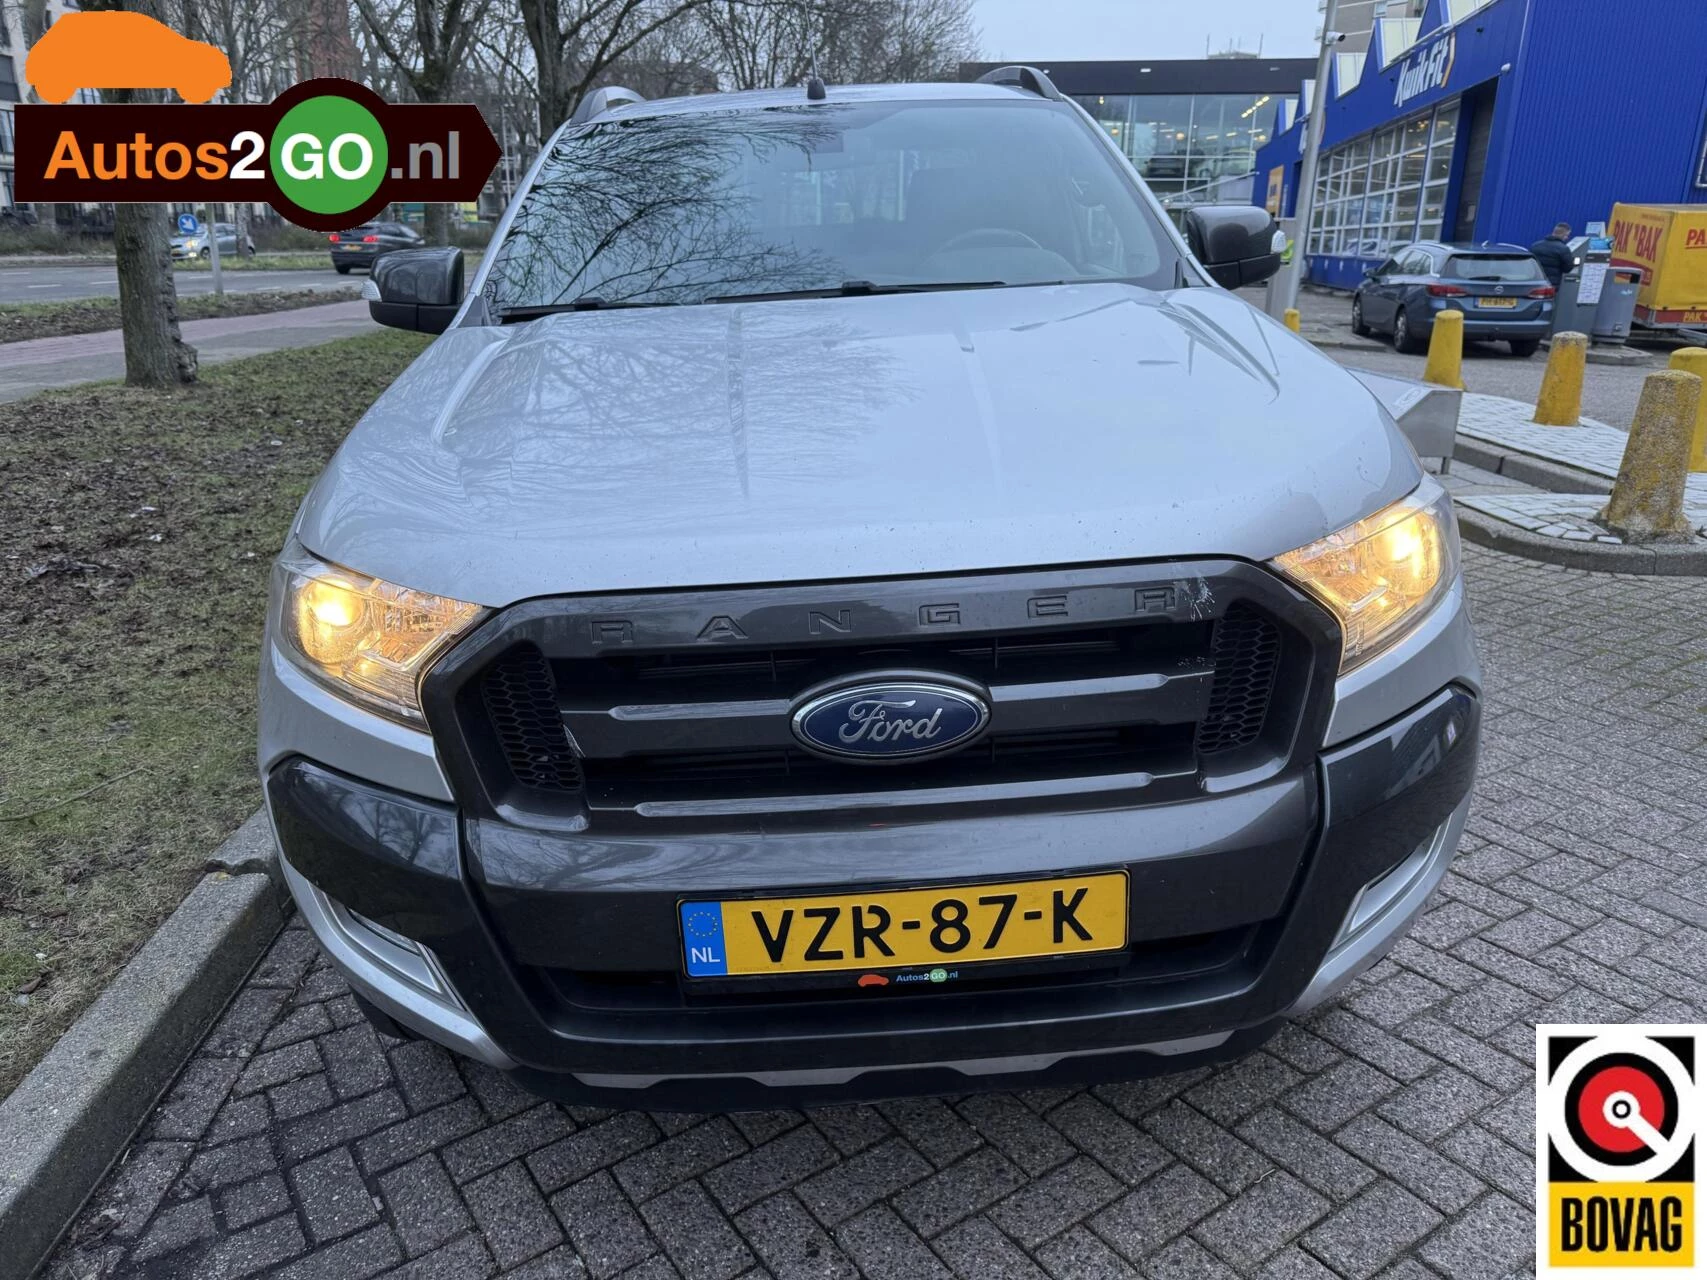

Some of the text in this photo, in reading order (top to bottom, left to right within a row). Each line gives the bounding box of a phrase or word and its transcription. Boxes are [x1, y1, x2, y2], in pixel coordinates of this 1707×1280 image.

[591, 586, 1176, 644] RANGER
[838, 701, 943, 744] Ford
[751, 887, 1093, 962] VZR-87-K
[691, 947, 720, 964] NL
[896, 970, 958, 983] Autos2GO.nl
